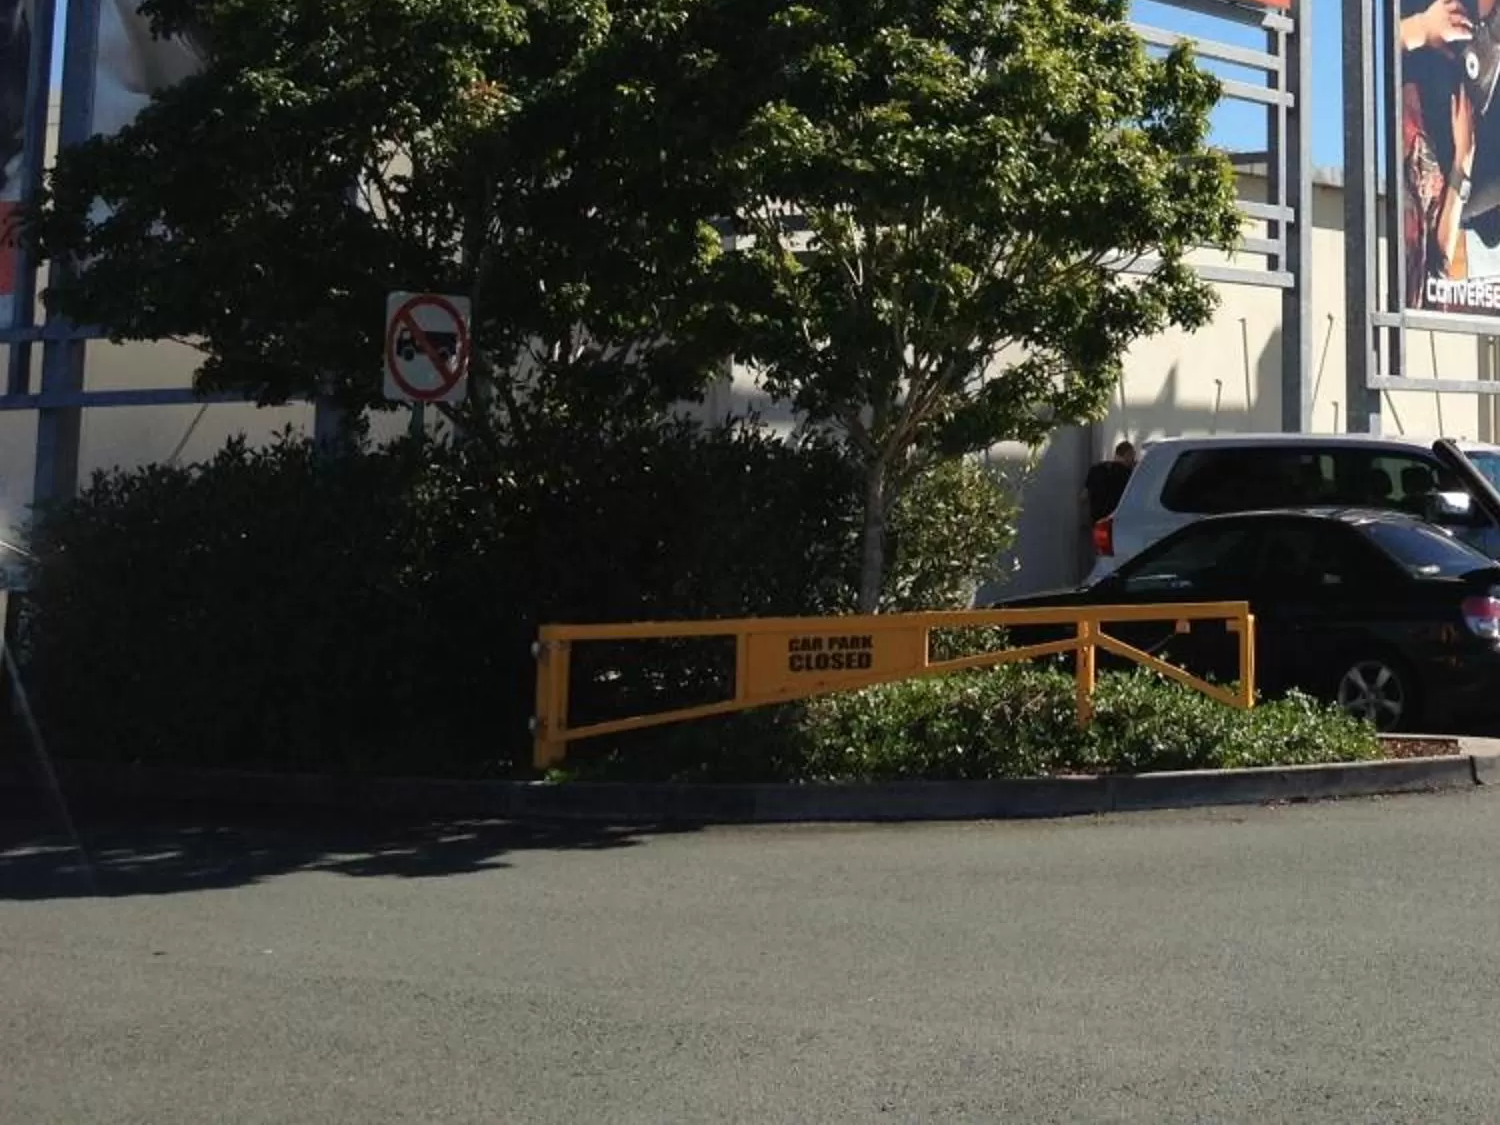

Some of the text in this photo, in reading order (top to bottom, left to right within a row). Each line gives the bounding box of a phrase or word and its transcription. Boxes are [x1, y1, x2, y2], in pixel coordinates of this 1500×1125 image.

[788, 634, 874, 652] CAR PARK
[788, 651, 872, 672] CLOSED
